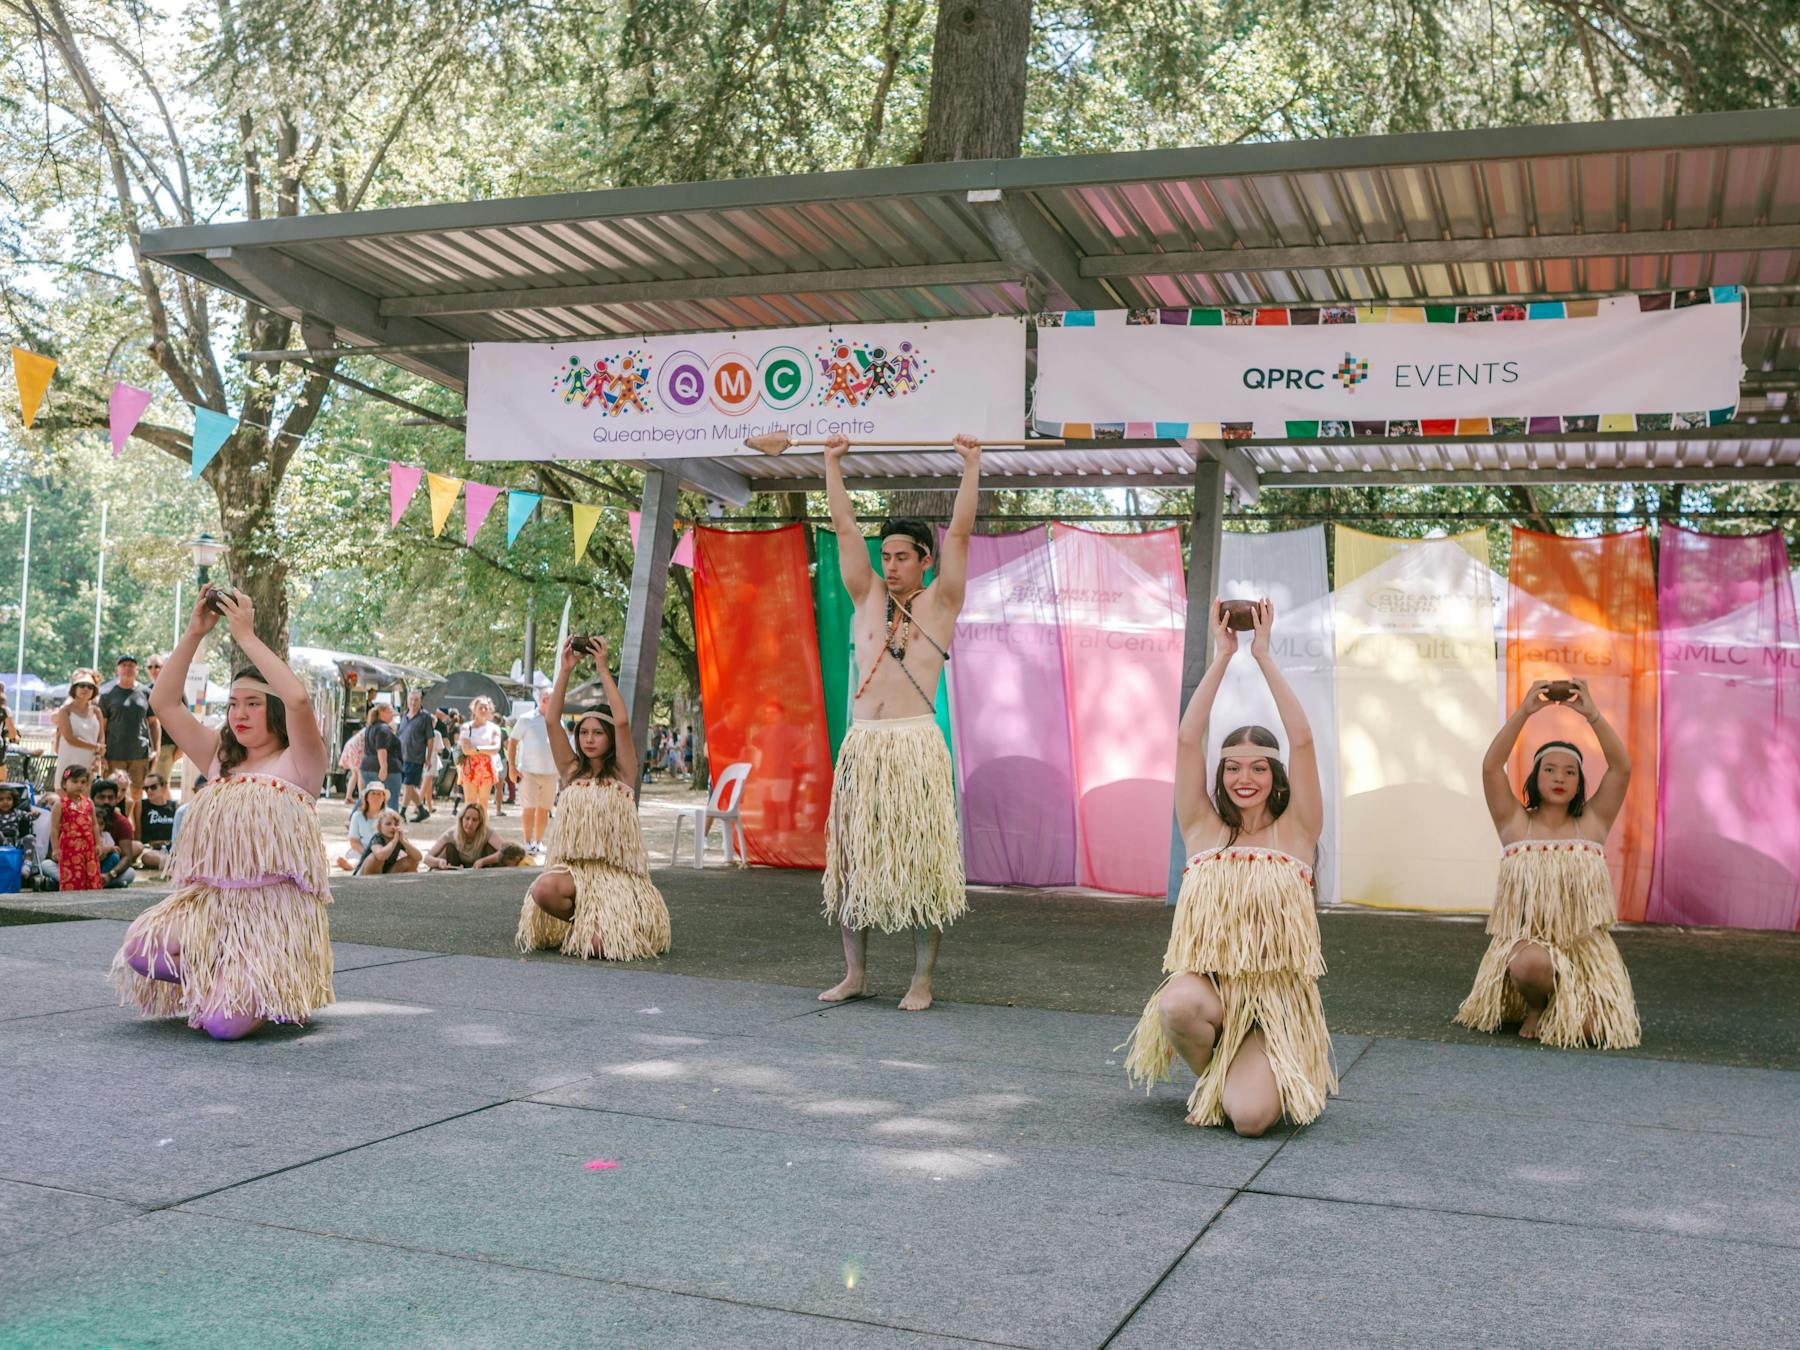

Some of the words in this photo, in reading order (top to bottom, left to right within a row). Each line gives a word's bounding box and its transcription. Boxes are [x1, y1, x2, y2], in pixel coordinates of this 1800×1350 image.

[1242, 367, 1325, 390] QPRC
[1395, 361, 1520, 388] EVENTS
[592, 425, 707, 444] Queanbeyan
[815, 417, 876, 435] Centre
